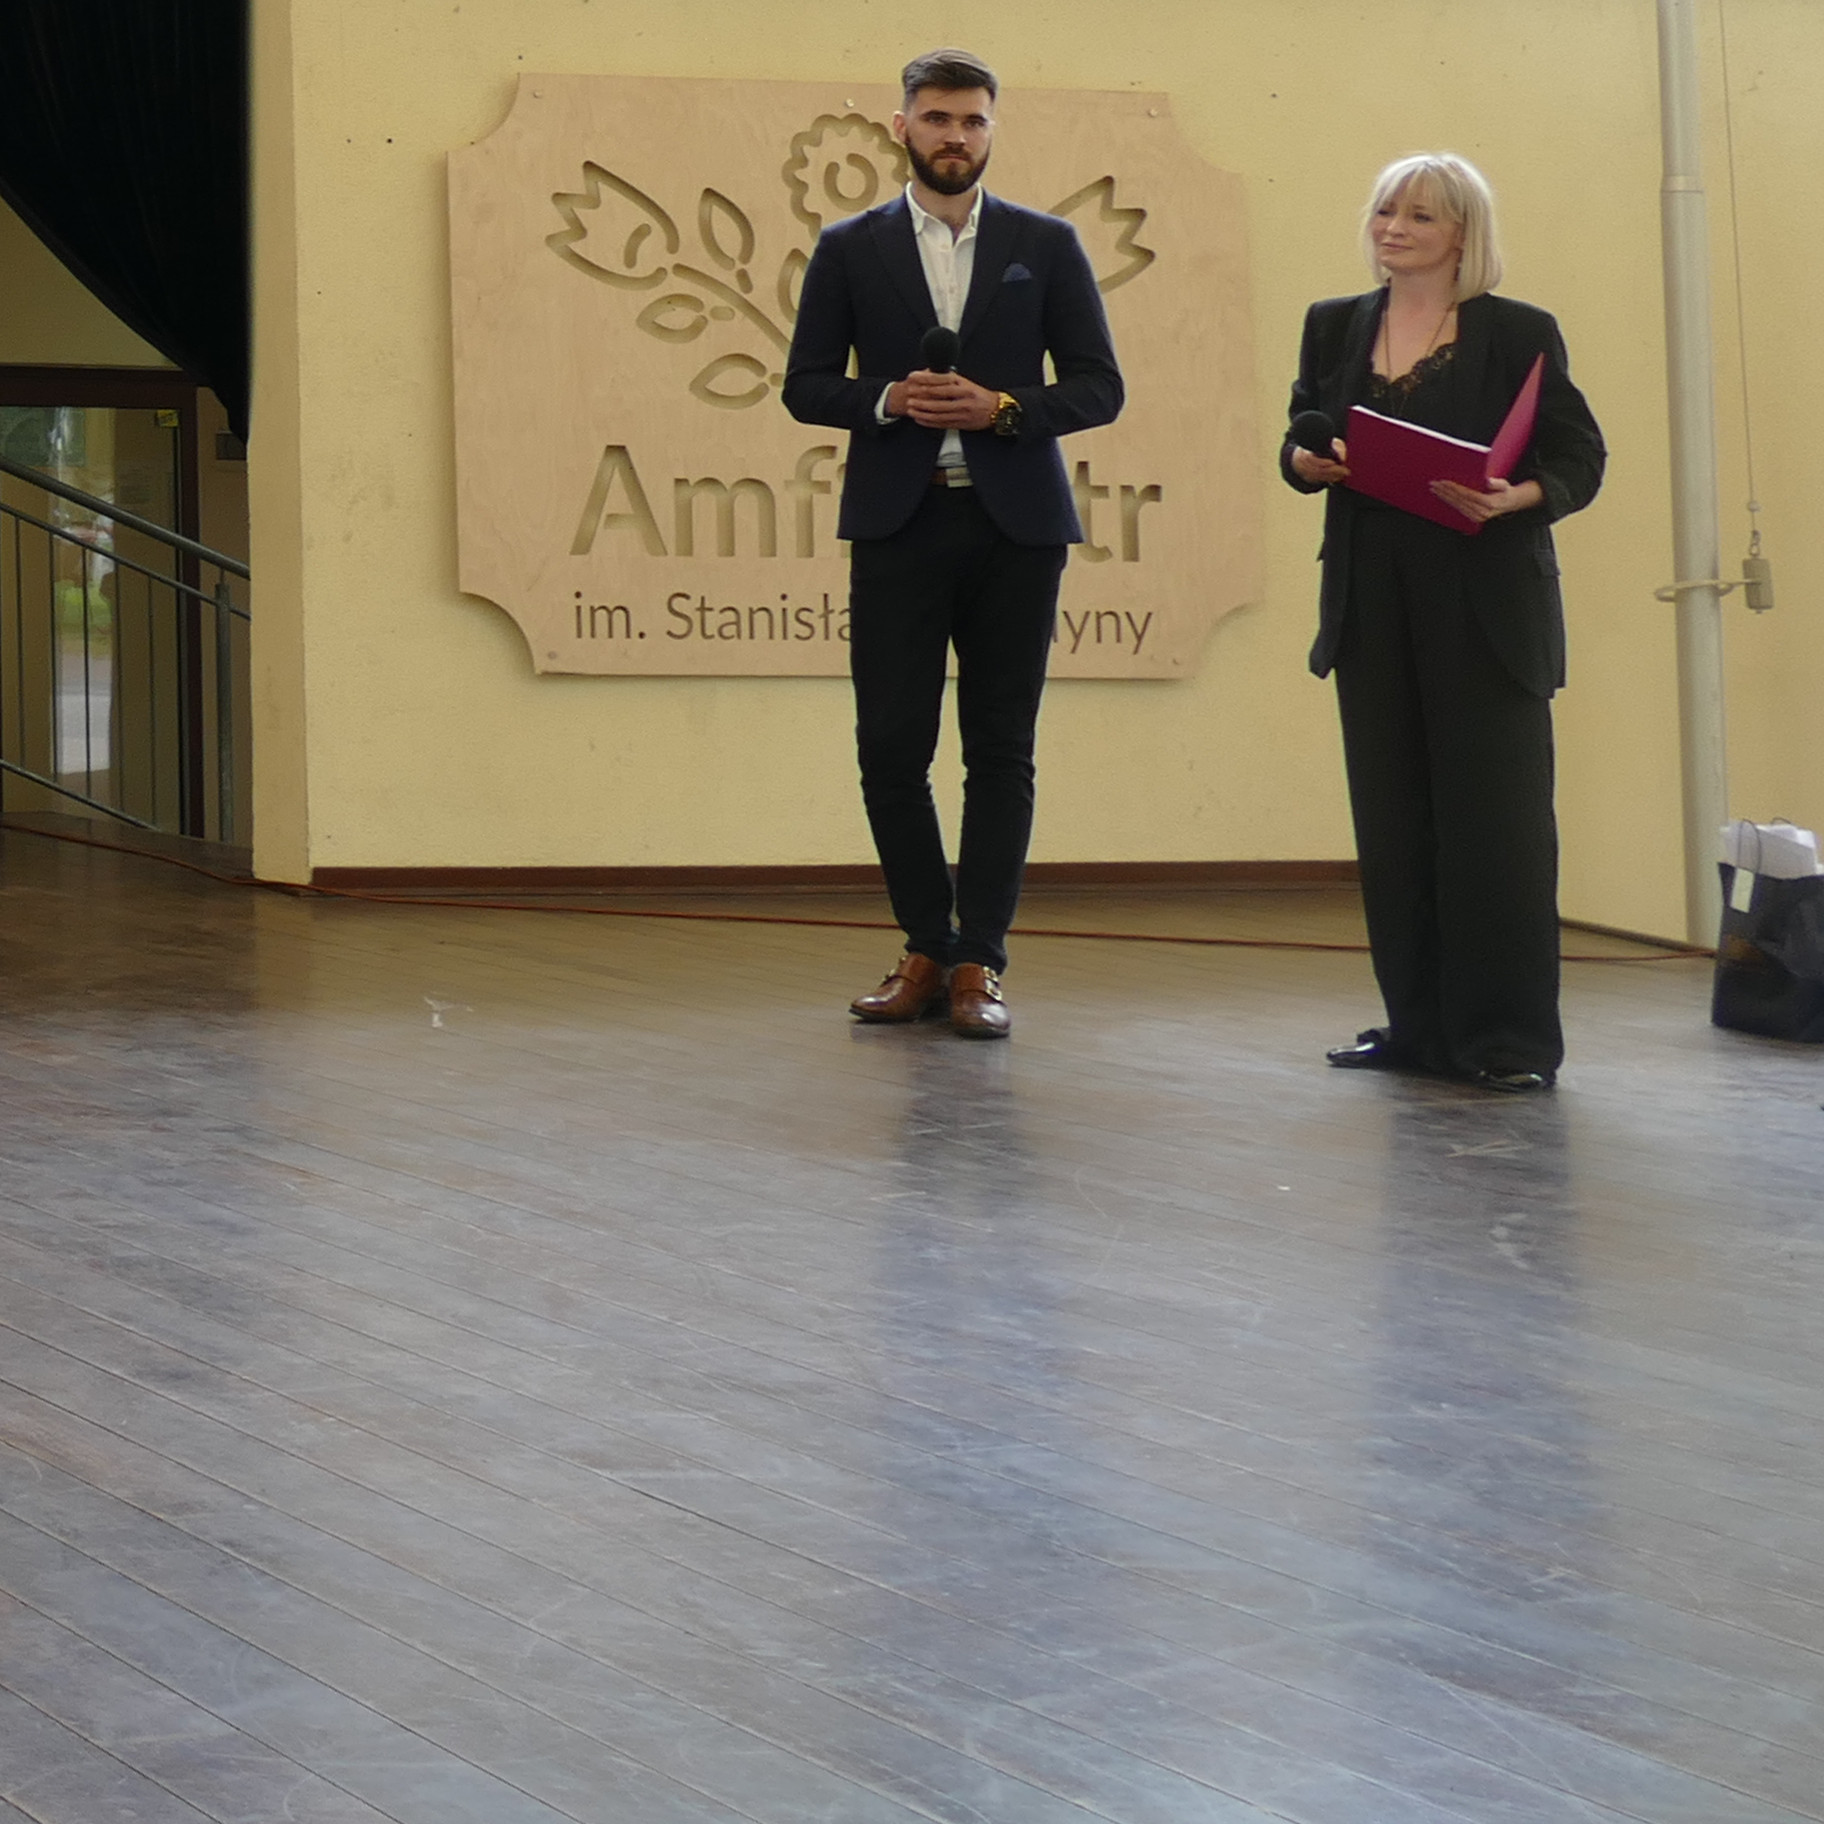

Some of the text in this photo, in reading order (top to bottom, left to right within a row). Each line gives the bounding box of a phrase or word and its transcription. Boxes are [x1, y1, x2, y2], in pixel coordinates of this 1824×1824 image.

[569, 444, 1163, 563] Amftr
[574, 591, 646, 639] im.
[666, 592, 852, 641] Stanisła
